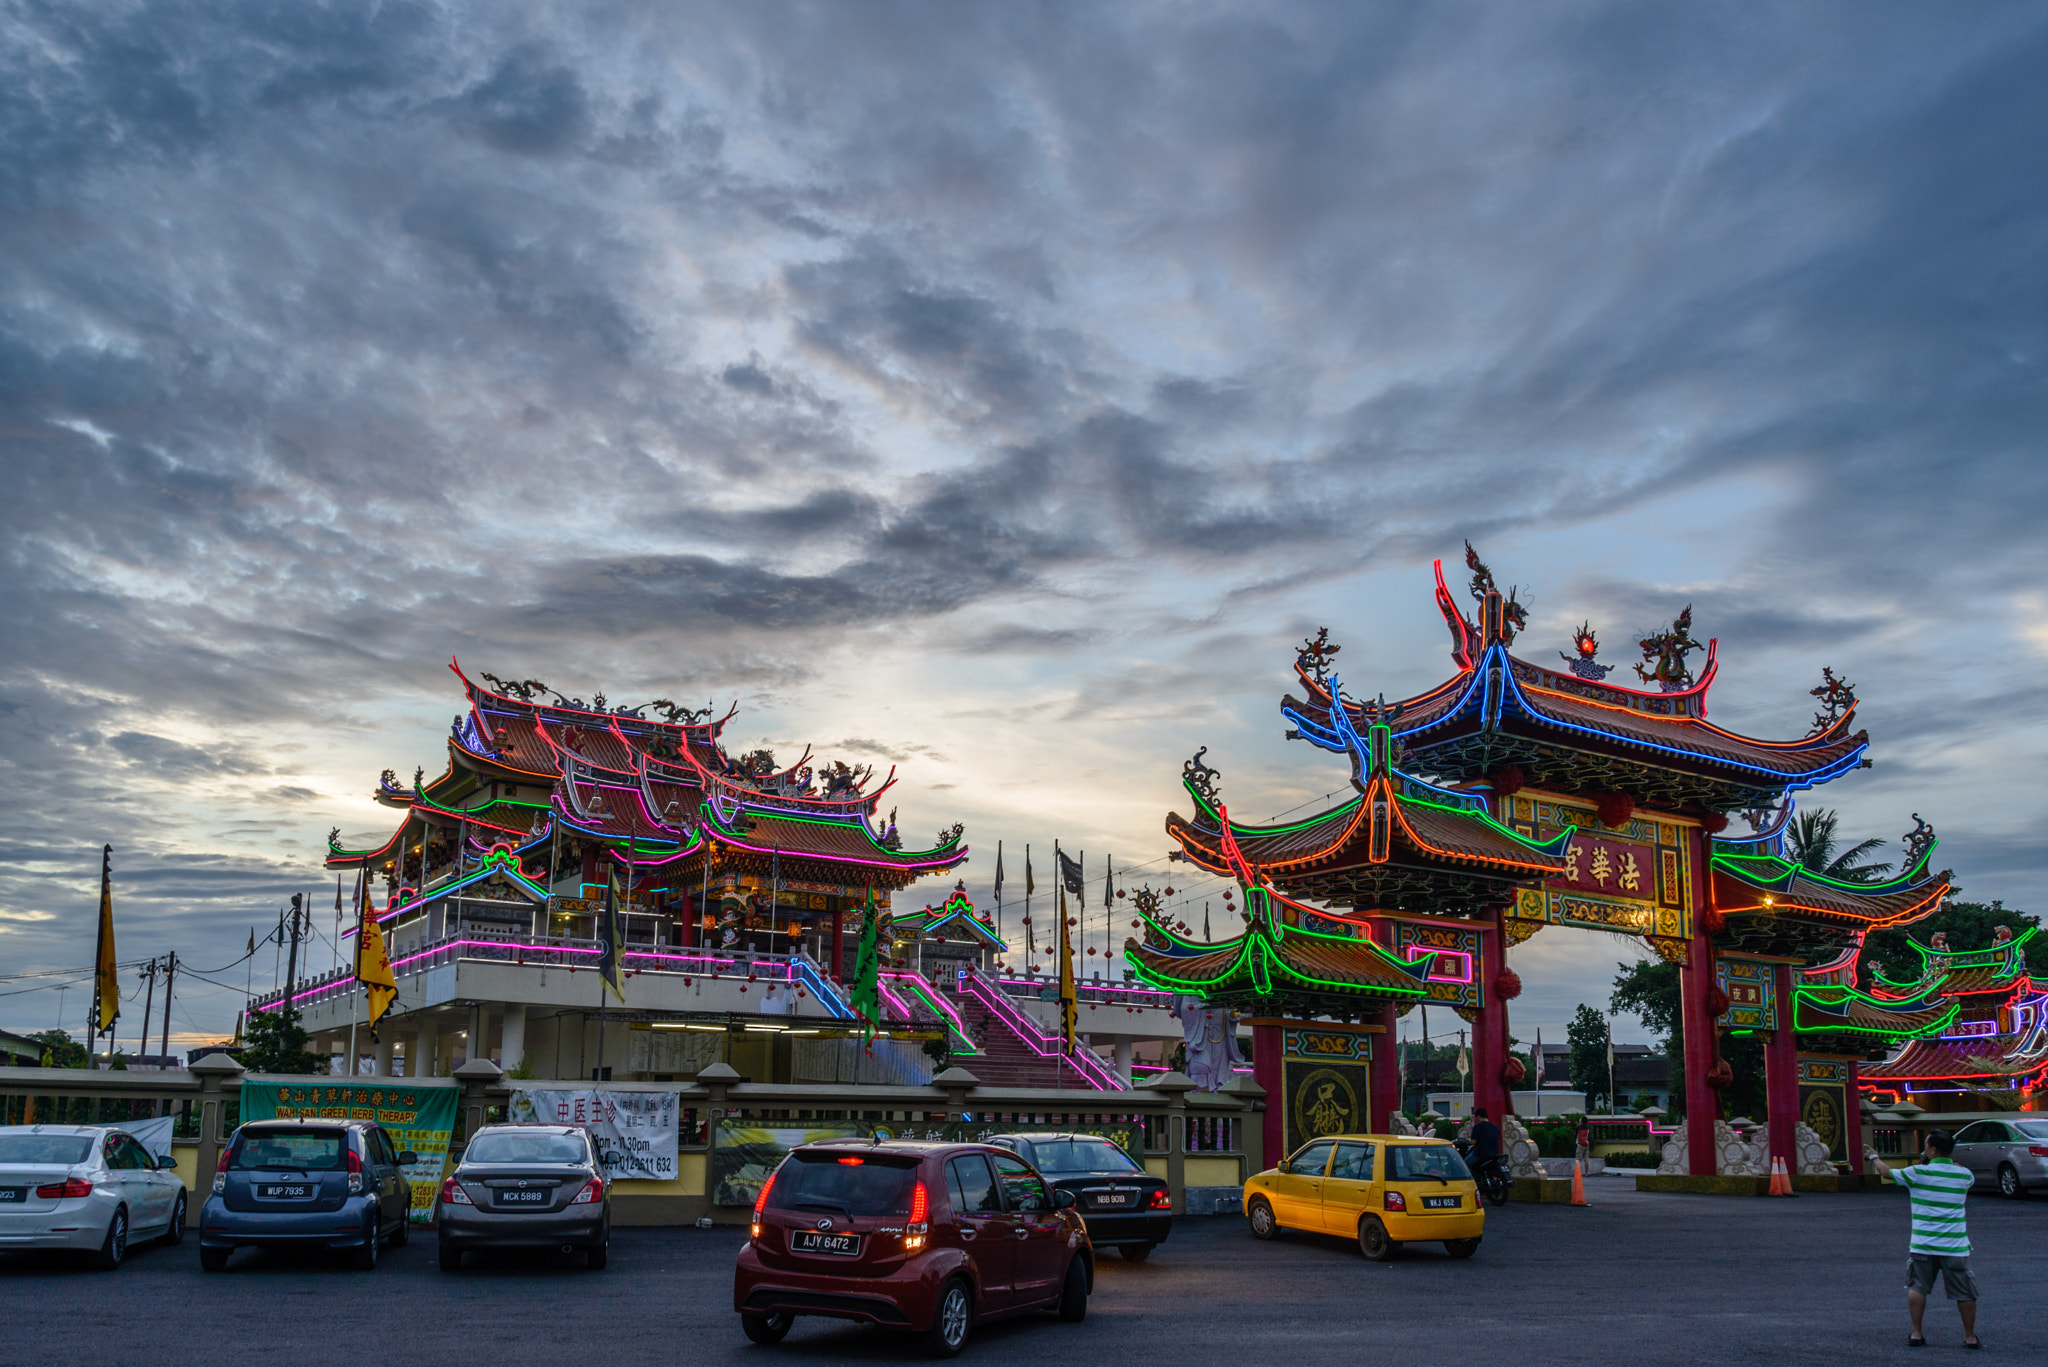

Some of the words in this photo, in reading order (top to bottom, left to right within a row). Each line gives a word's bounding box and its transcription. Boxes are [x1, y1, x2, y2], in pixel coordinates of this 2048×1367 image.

[276, 1107, 295, 1118] WAH
[299, 1107, 317, 1118] SAN
[320, 1107, 348, 1119] GREEN
[351, 1107, 375, 1120] HERB
[378, 1109, 417, 1123] THERAPY
[656, 1157, 671, 1172] 632
[267, 1187, 283, 1195] WUP
[285, 1187, 304, 1195] 7935
[503, 1192, 520, 1201] MCK
[521, 1192, 542, 1201] 5889
[1443, 1198, 1455, 1206] 652
[803, 1234, 822, 1248] AJY
[824, 1236, 849, 1250] 6472
